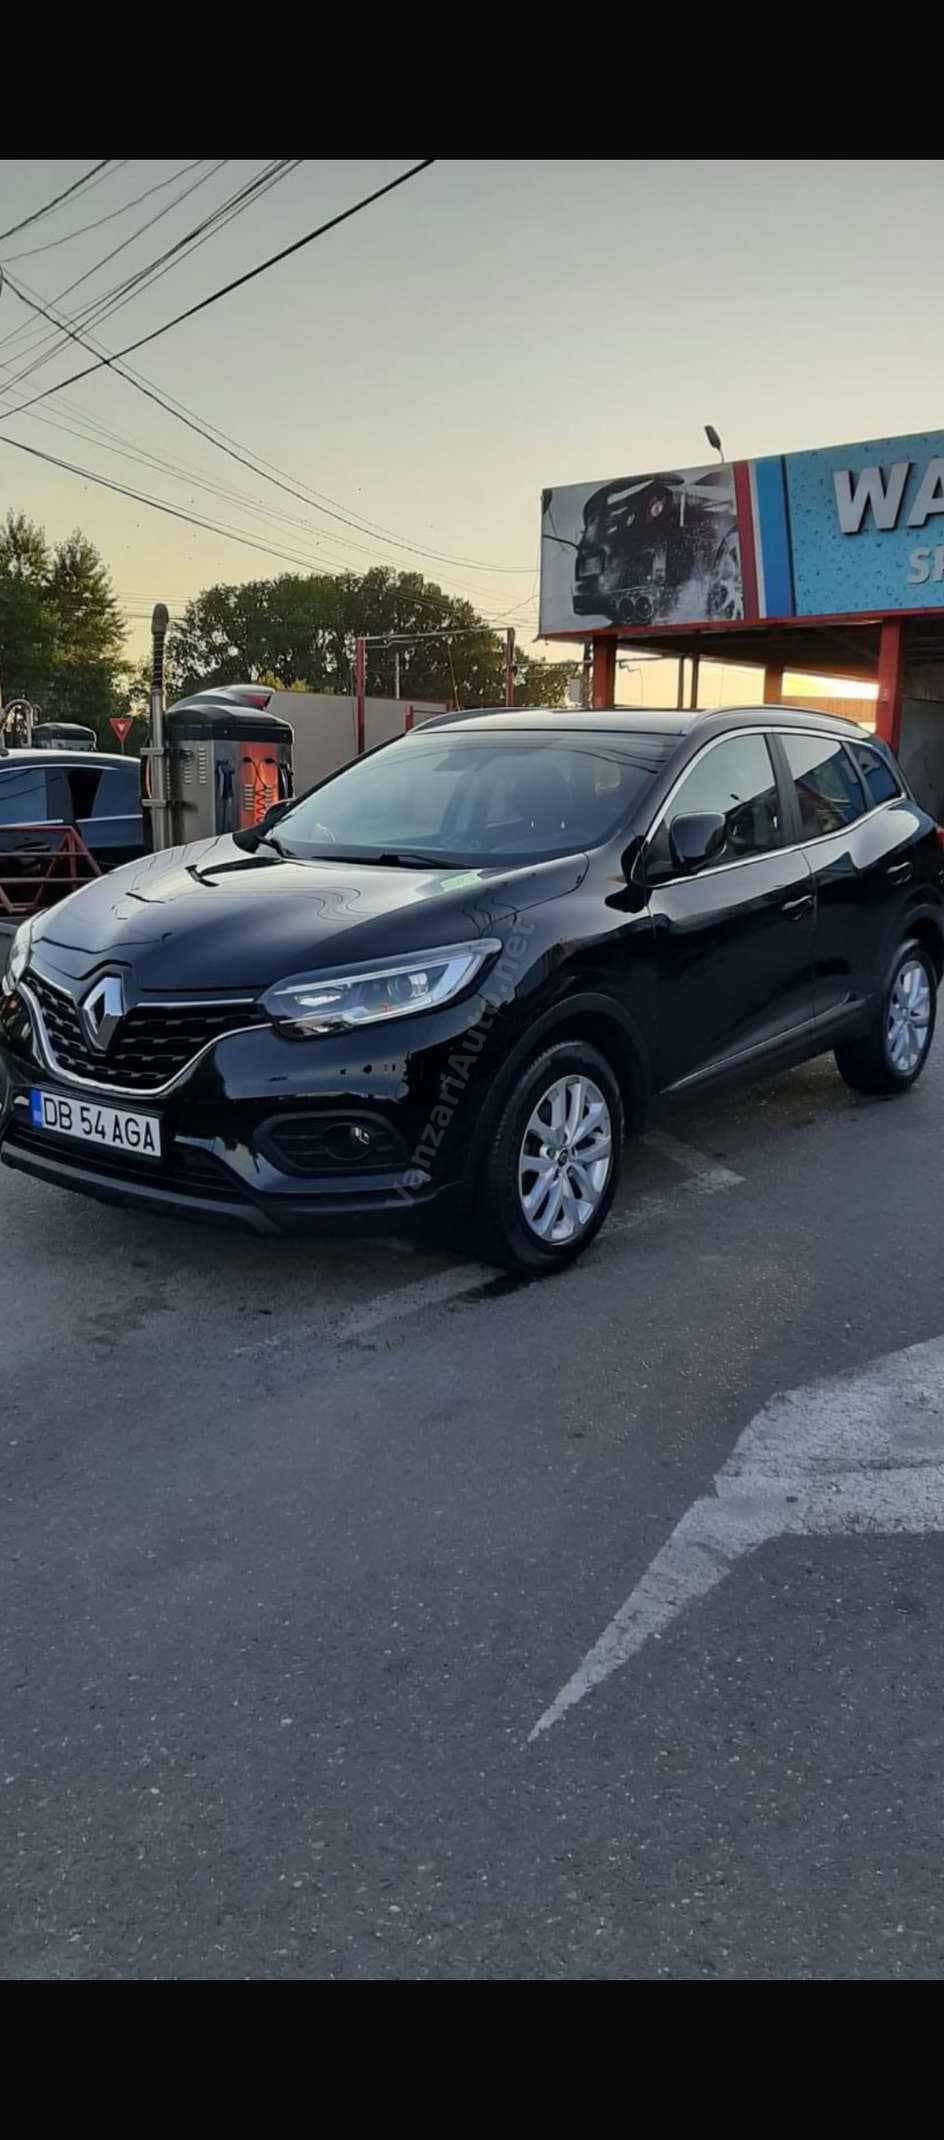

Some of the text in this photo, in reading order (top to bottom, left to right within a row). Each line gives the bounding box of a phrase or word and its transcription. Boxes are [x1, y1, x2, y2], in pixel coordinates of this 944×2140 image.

[832, 458, 944, 534] WA
[43, 1097, 156, 1152] DB 54 AGA
